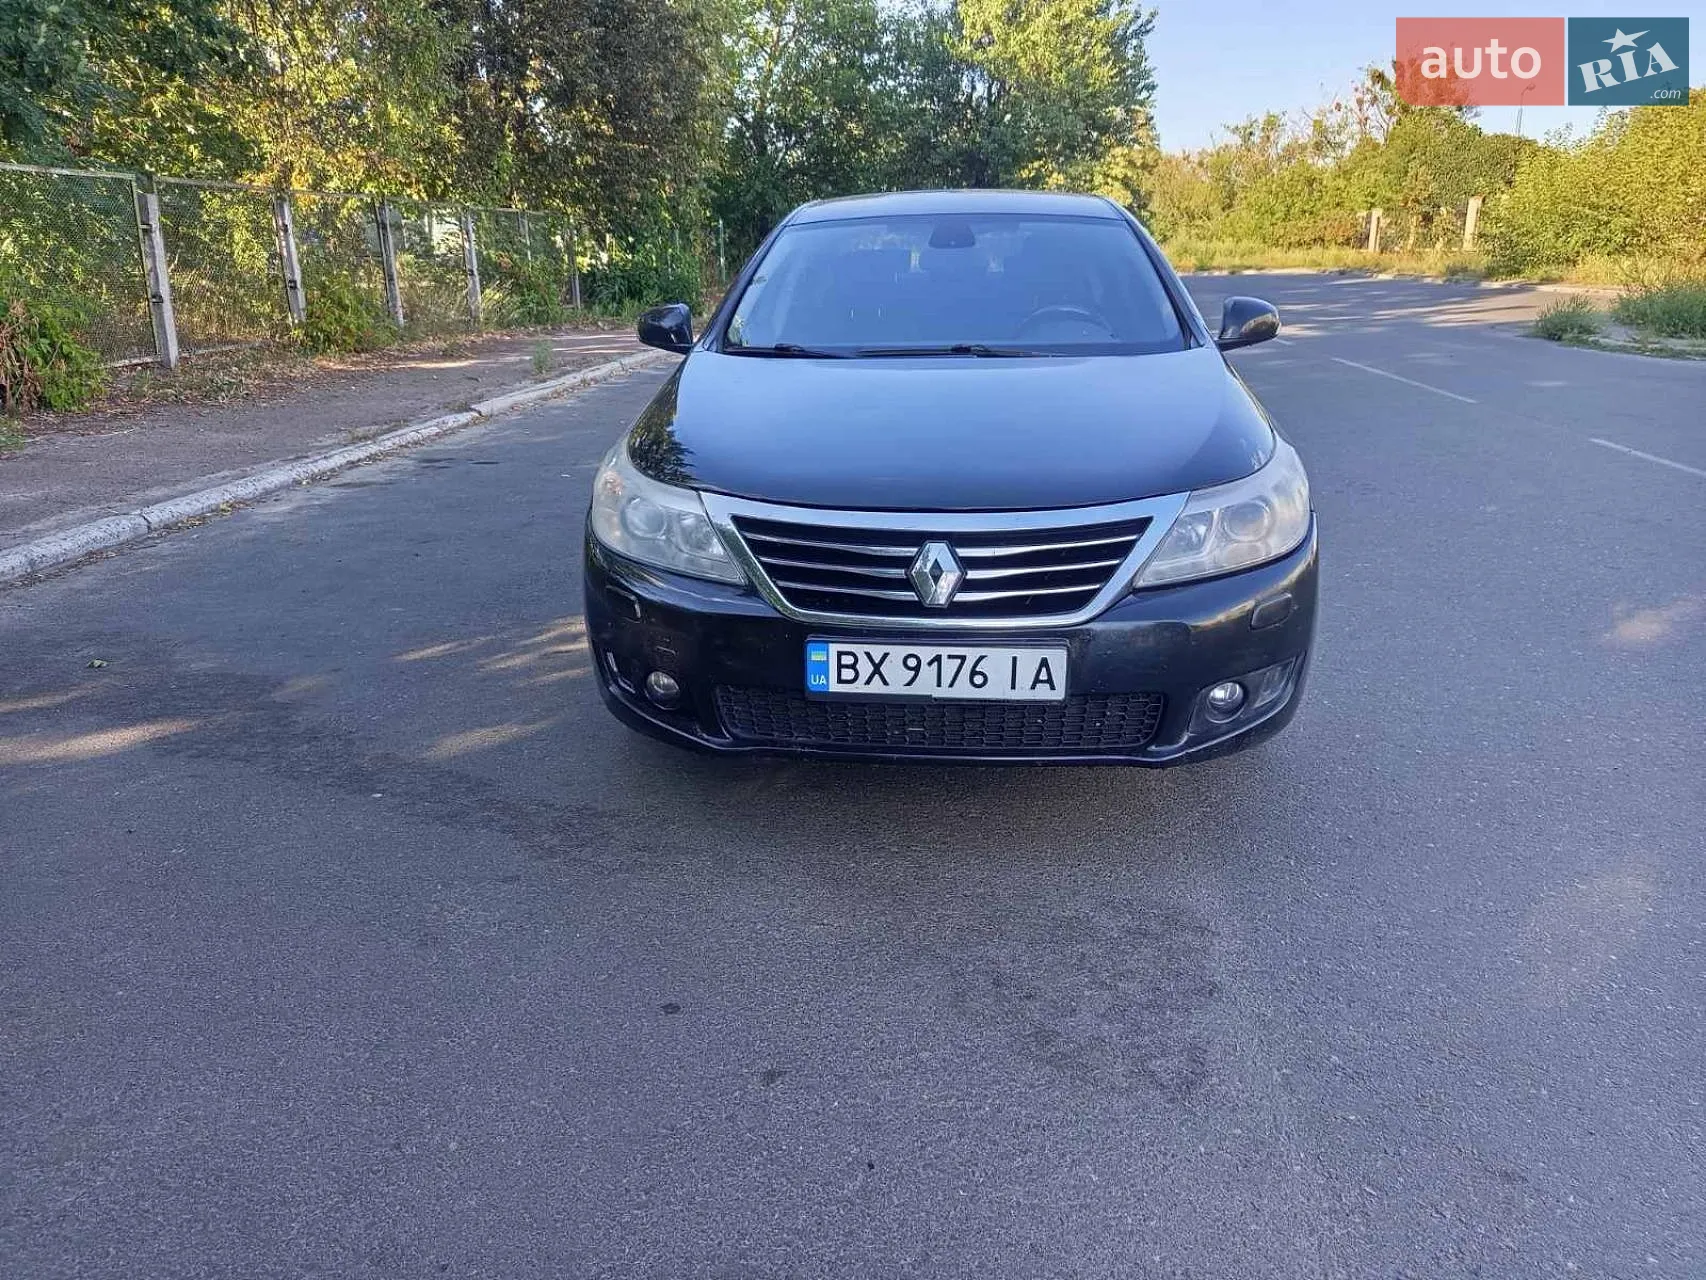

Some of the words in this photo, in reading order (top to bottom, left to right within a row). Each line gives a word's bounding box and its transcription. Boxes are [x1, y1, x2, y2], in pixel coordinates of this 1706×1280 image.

[811, 675, 827, 685] UA
[836, 650, 890, 686] BX
[902, 653, 989, 688] 9176
[1010, 655, 1056, 690] IA
